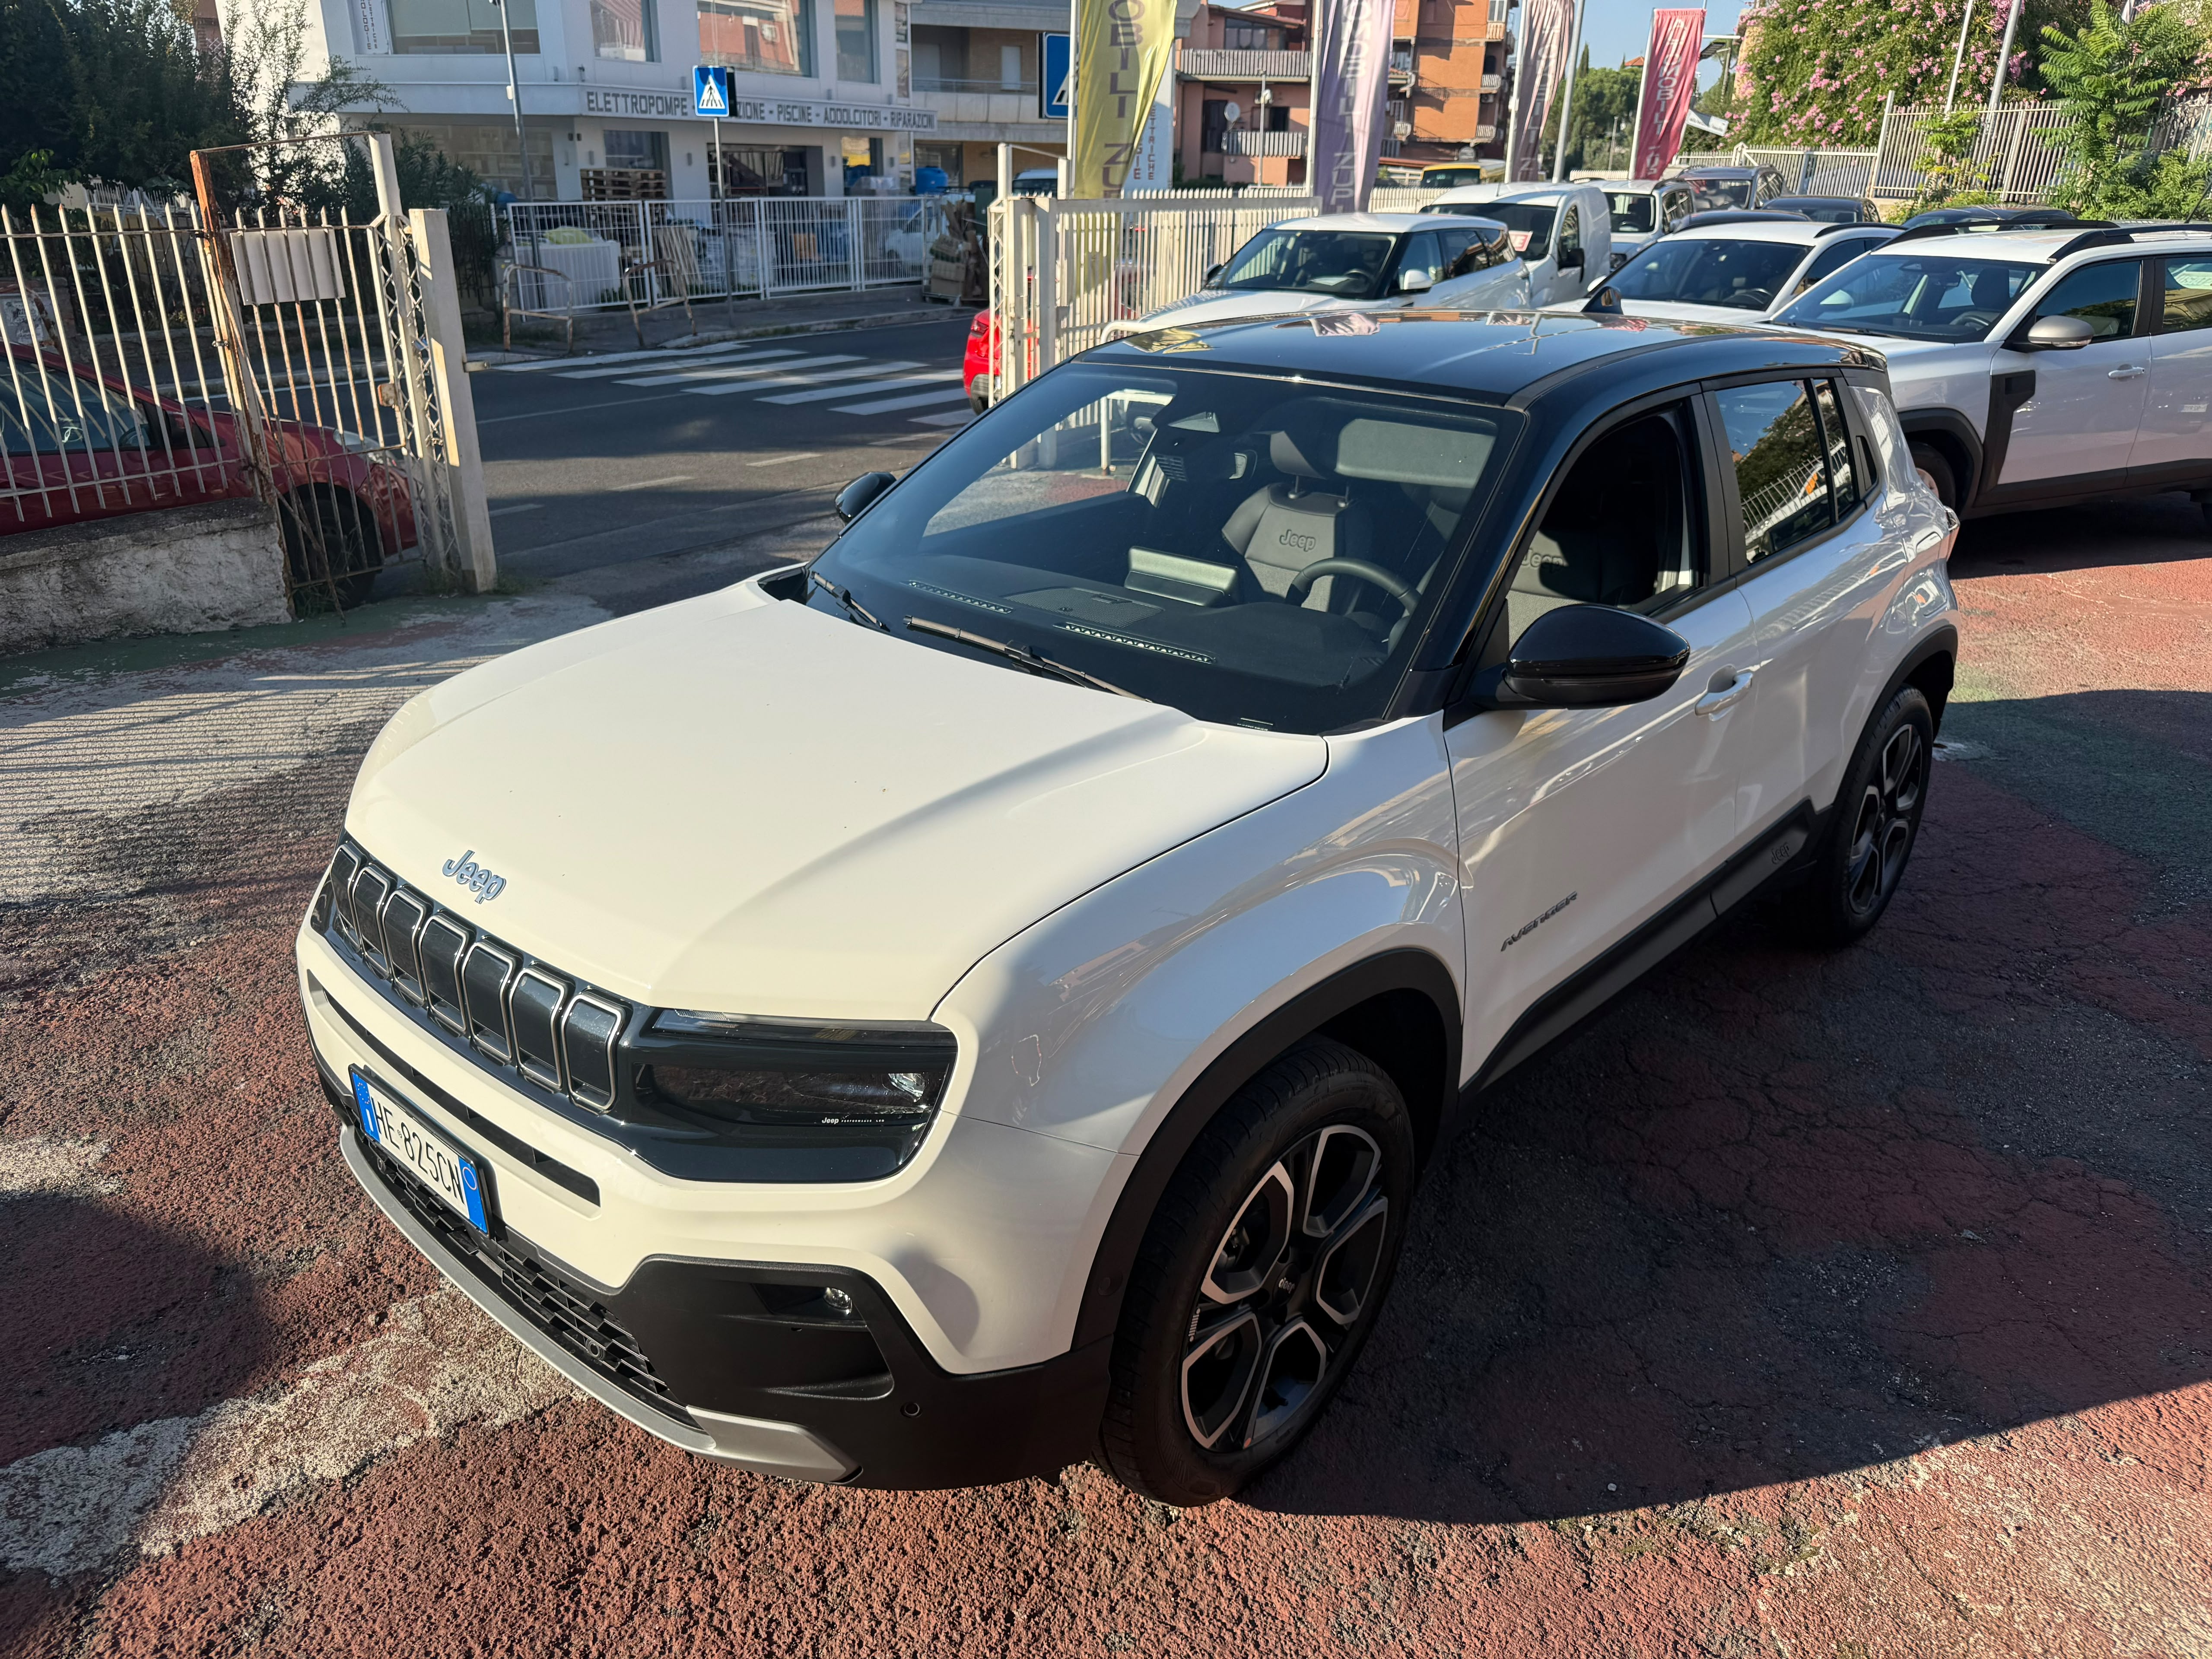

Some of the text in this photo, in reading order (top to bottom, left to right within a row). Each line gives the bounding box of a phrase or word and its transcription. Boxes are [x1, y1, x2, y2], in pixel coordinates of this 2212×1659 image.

[361, 0, 371, 50] OLOGIE
[587, 91, 688, 116] ELETTROPOMPE
[737, 101, 765, 120] ZIONE
[777, 104, 812, 123] PISCINE
[823, 107, 881, 126] ADDOLCITORI
[890, 111, 935, 129] RIPARAZIONI
[1279, 529, 1316, 552] Jeep
[442, 849, 506, 904] Jeep
[1500, 890, 1578, 952] AVENGER
